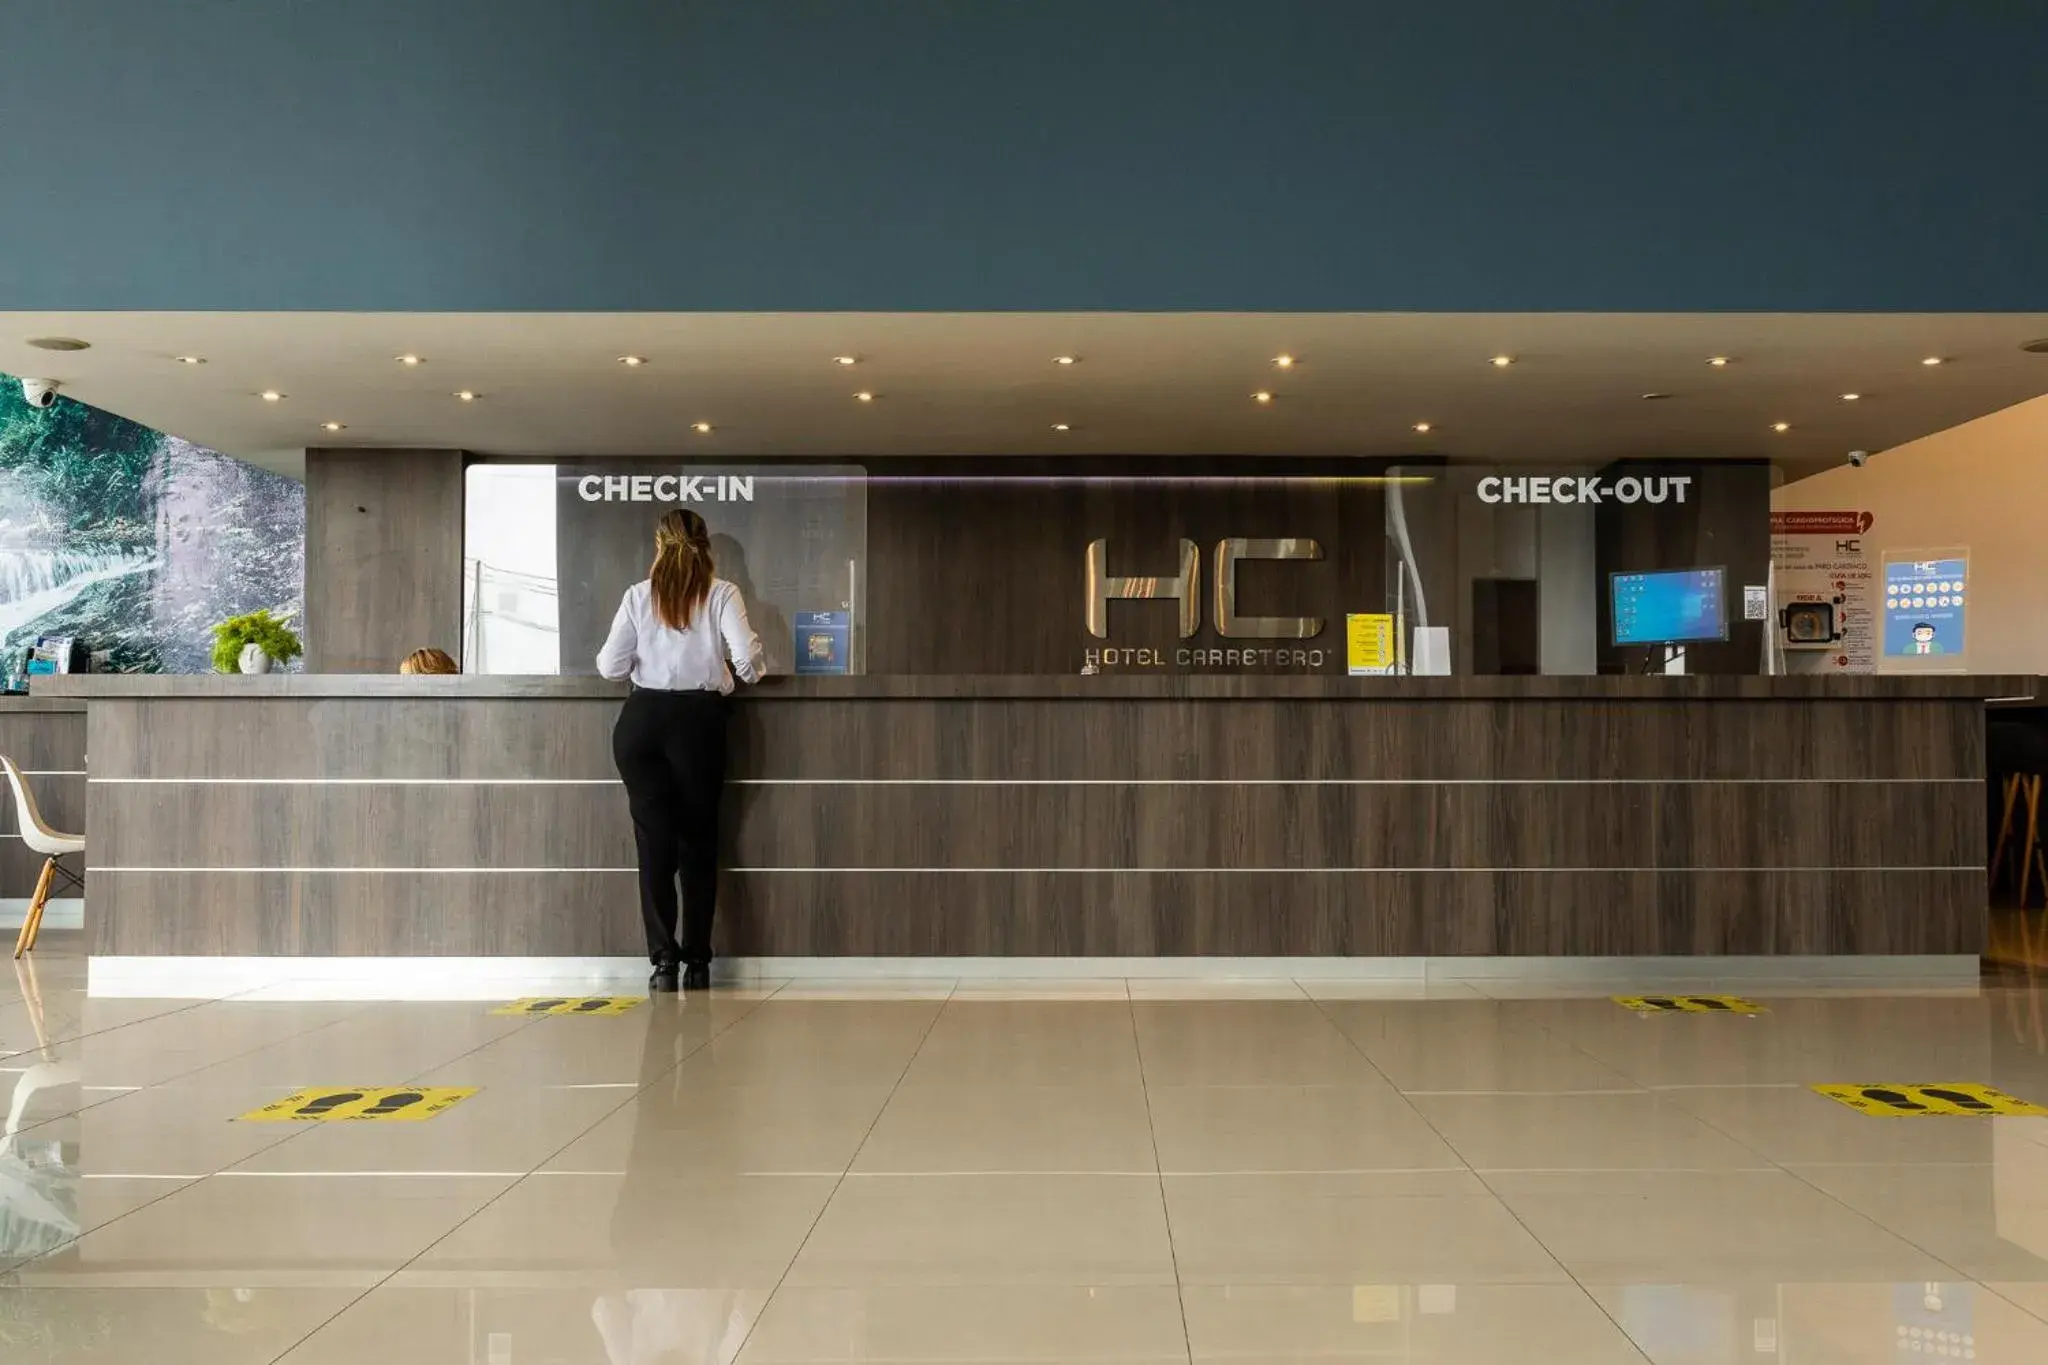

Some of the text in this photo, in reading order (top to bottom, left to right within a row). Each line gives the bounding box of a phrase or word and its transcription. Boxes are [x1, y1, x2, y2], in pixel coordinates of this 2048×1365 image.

[578, 474, 754, 502] CHECK-IN
[1476, 476, 1692, 503] CHECK-OUT
[1835, 539, 1861, 552] HC
[1085, 537, 1325, 638] HC
[1084, 648, 1166, 666] HOTEL
